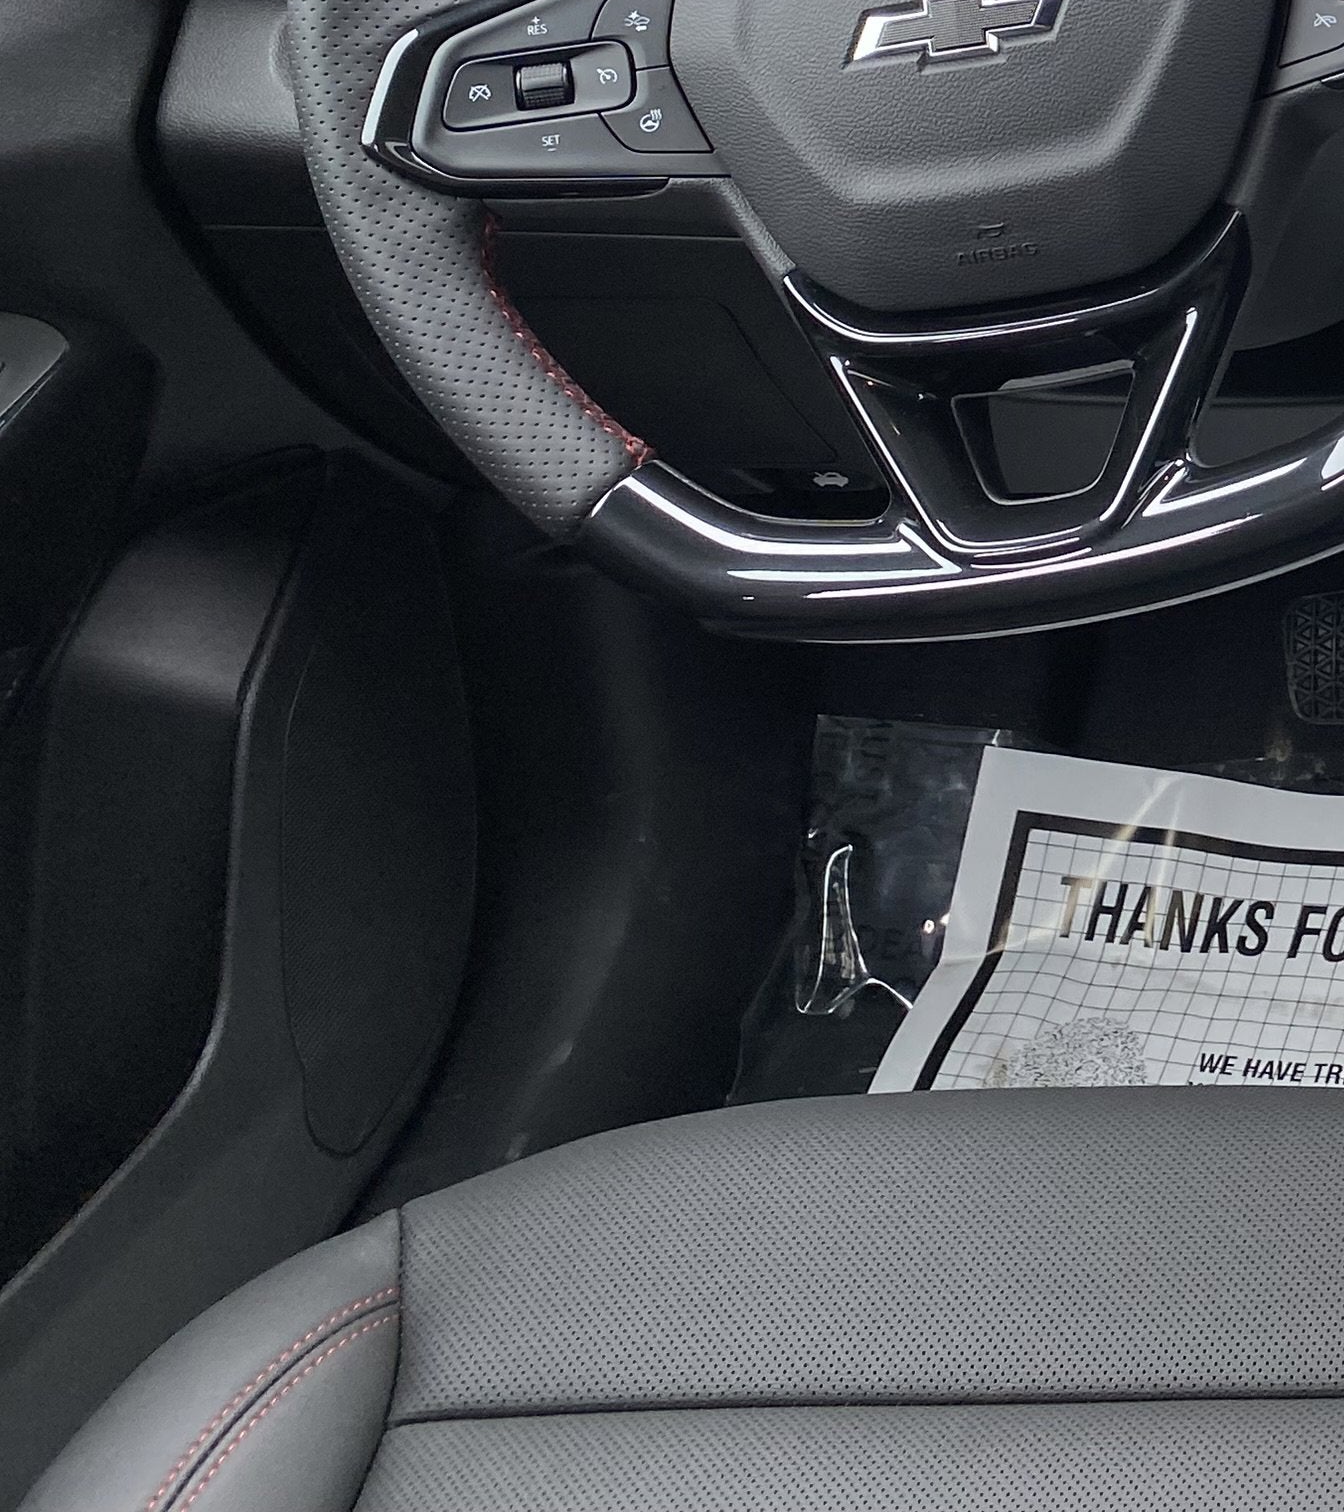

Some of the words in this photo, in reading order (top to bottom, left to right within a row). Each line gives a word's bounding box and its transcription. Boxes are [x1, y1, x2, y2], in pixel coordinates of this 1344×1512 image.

[526, 23, 548, 36] RES
[541, 134, 560, 147] SET
[1059, 876, 1276, 957] THANKS
[1199, 1053, 1238, 1076] WE
[1242, 1058, 1307, 1082] HAVE
